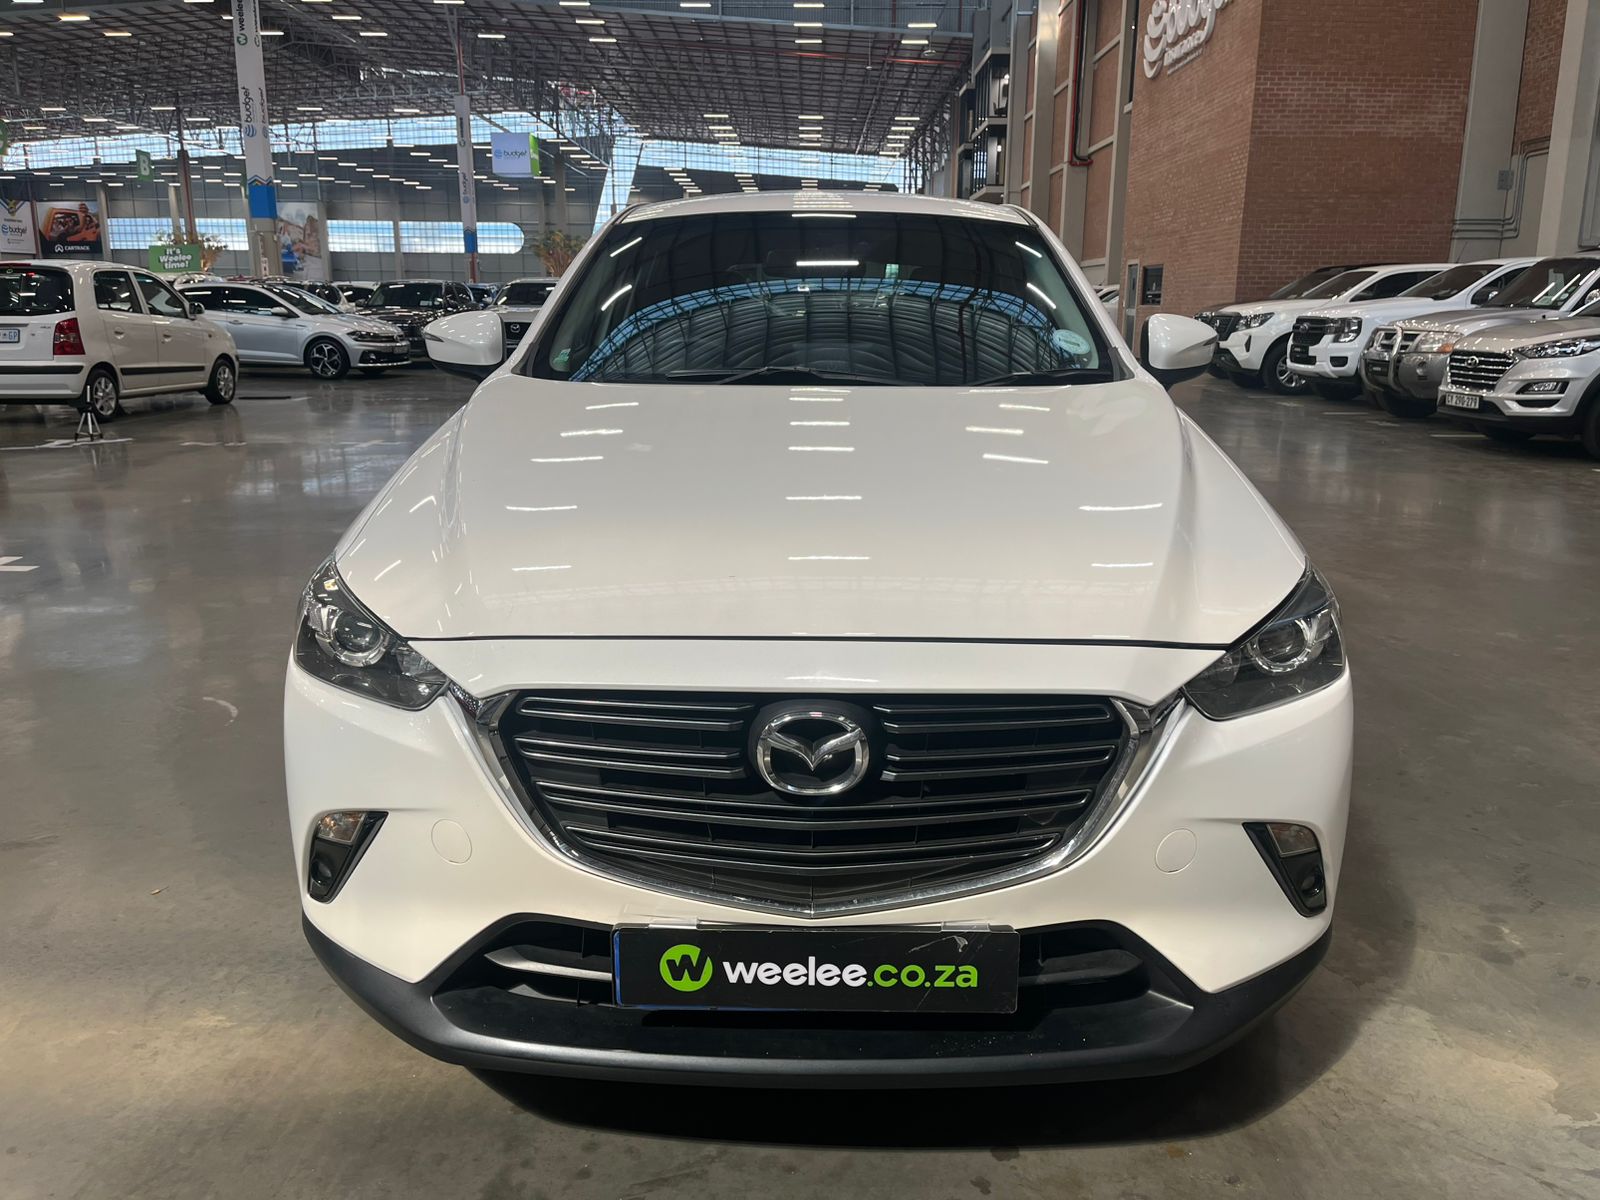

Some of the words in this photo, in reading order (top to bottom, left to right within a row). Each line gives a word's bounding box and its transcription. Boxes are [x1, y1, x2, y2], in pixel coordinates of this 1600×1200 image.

[241, 86, 253, 123] budget
[503, 149, 527, 158] budget
[8, 225, 27, 237] budget
[722, 956, 978, 987] weelee.co.za
